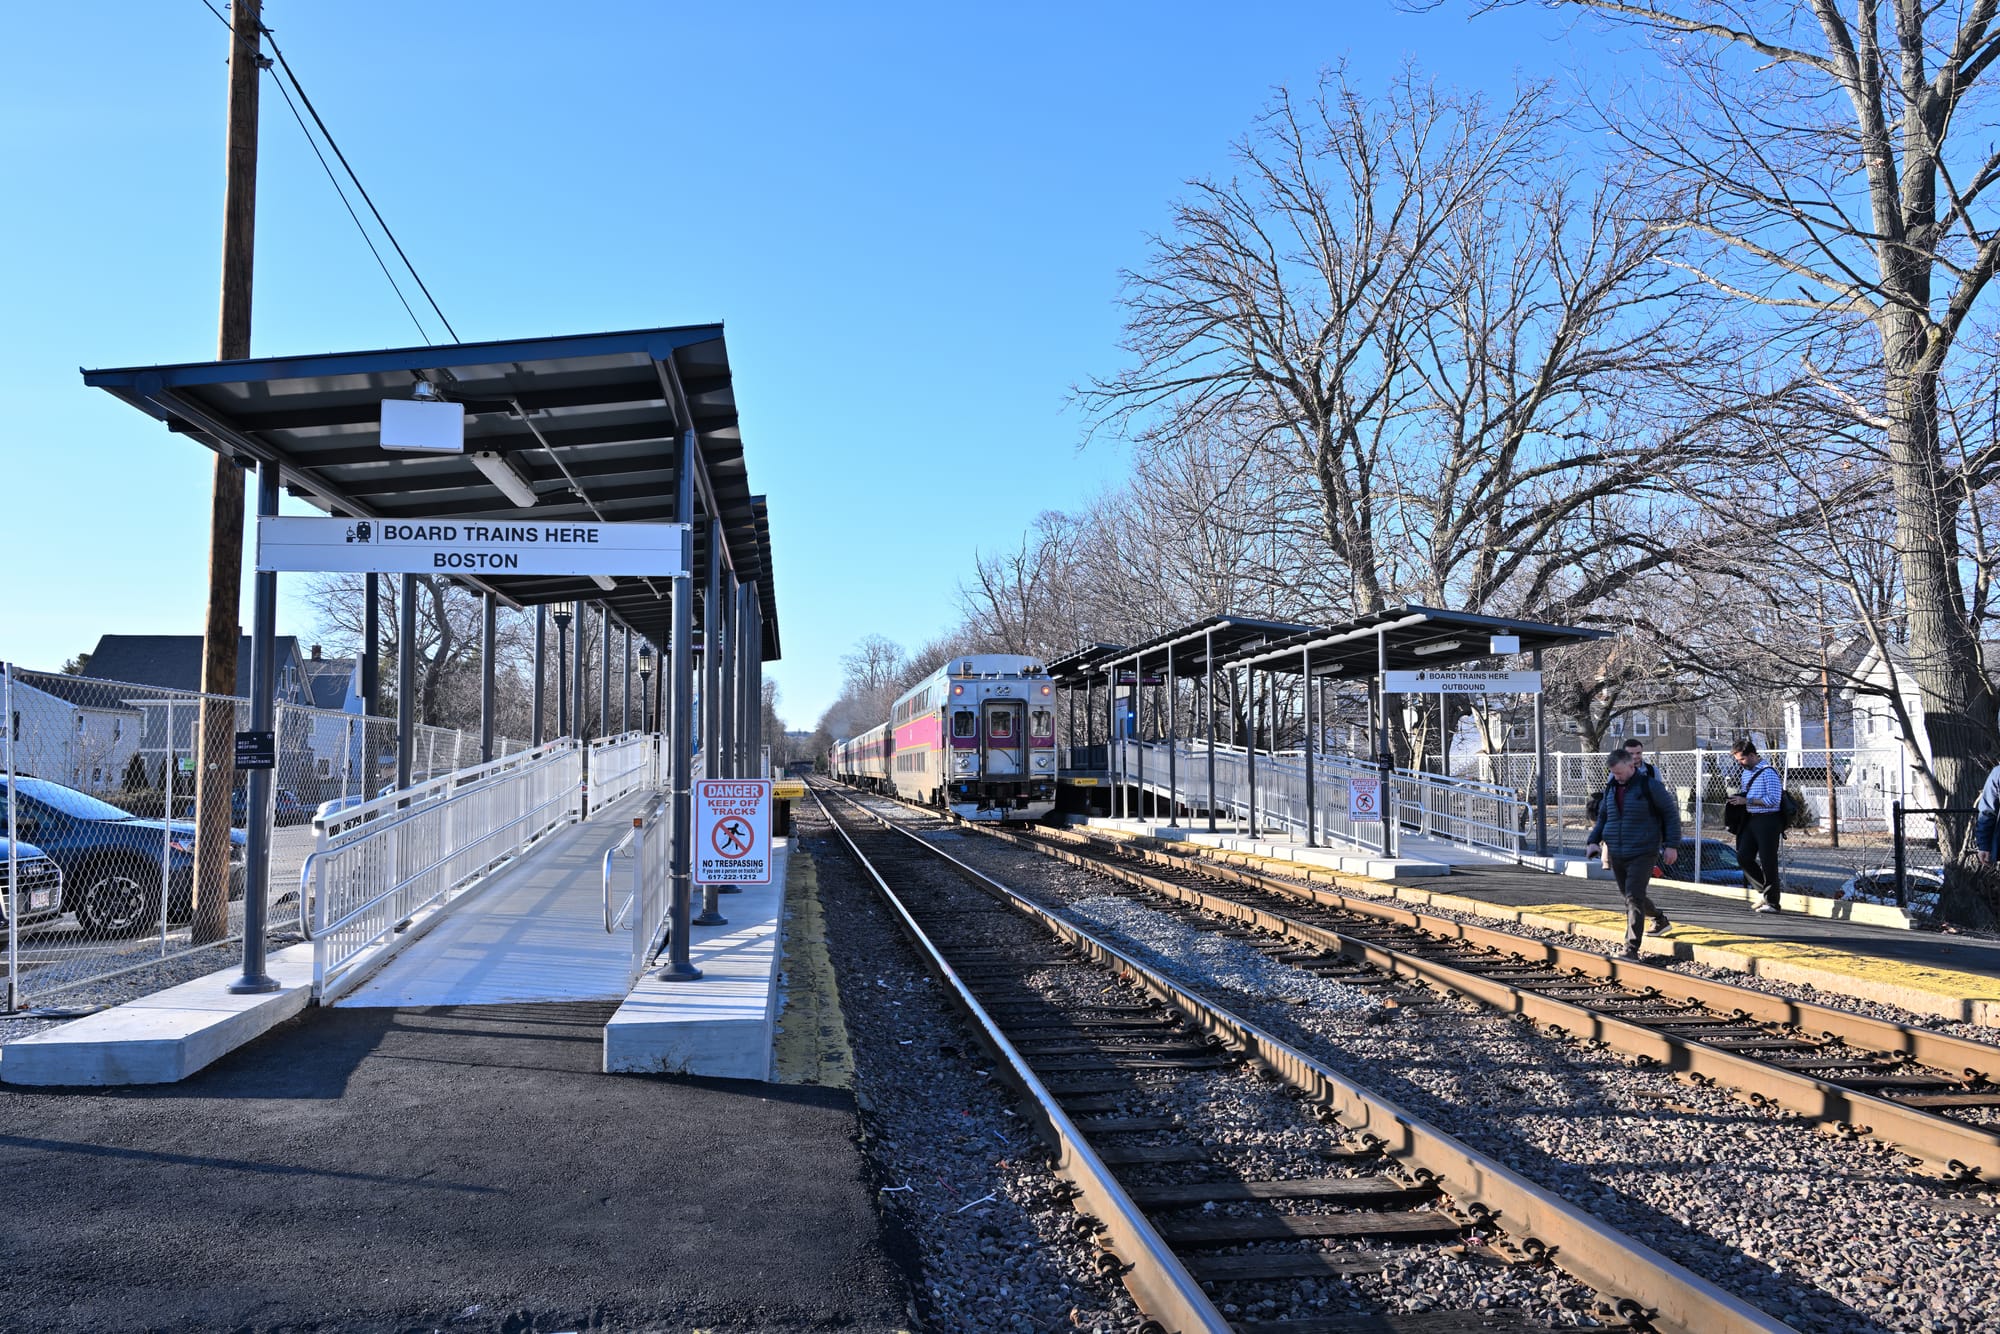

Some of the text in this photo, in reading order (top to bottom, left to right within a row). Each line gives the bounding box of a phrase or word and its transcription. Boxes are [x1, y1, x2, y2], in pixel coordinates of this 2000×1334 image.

[384, 525, 600, 543] BOARD TRAINS HERE
[433, 552, 518, 569] BOSTON
[1429, 672, 1510, 680] BOARD TRAINS HERE
[1441, 683, 1486, 691] OUTBOUND
[708, 785, 760, 797] DANGER
[707, 799, 761, 807] KEEP OFF
[702, 860, 764, 868] NO TRESPASSING
